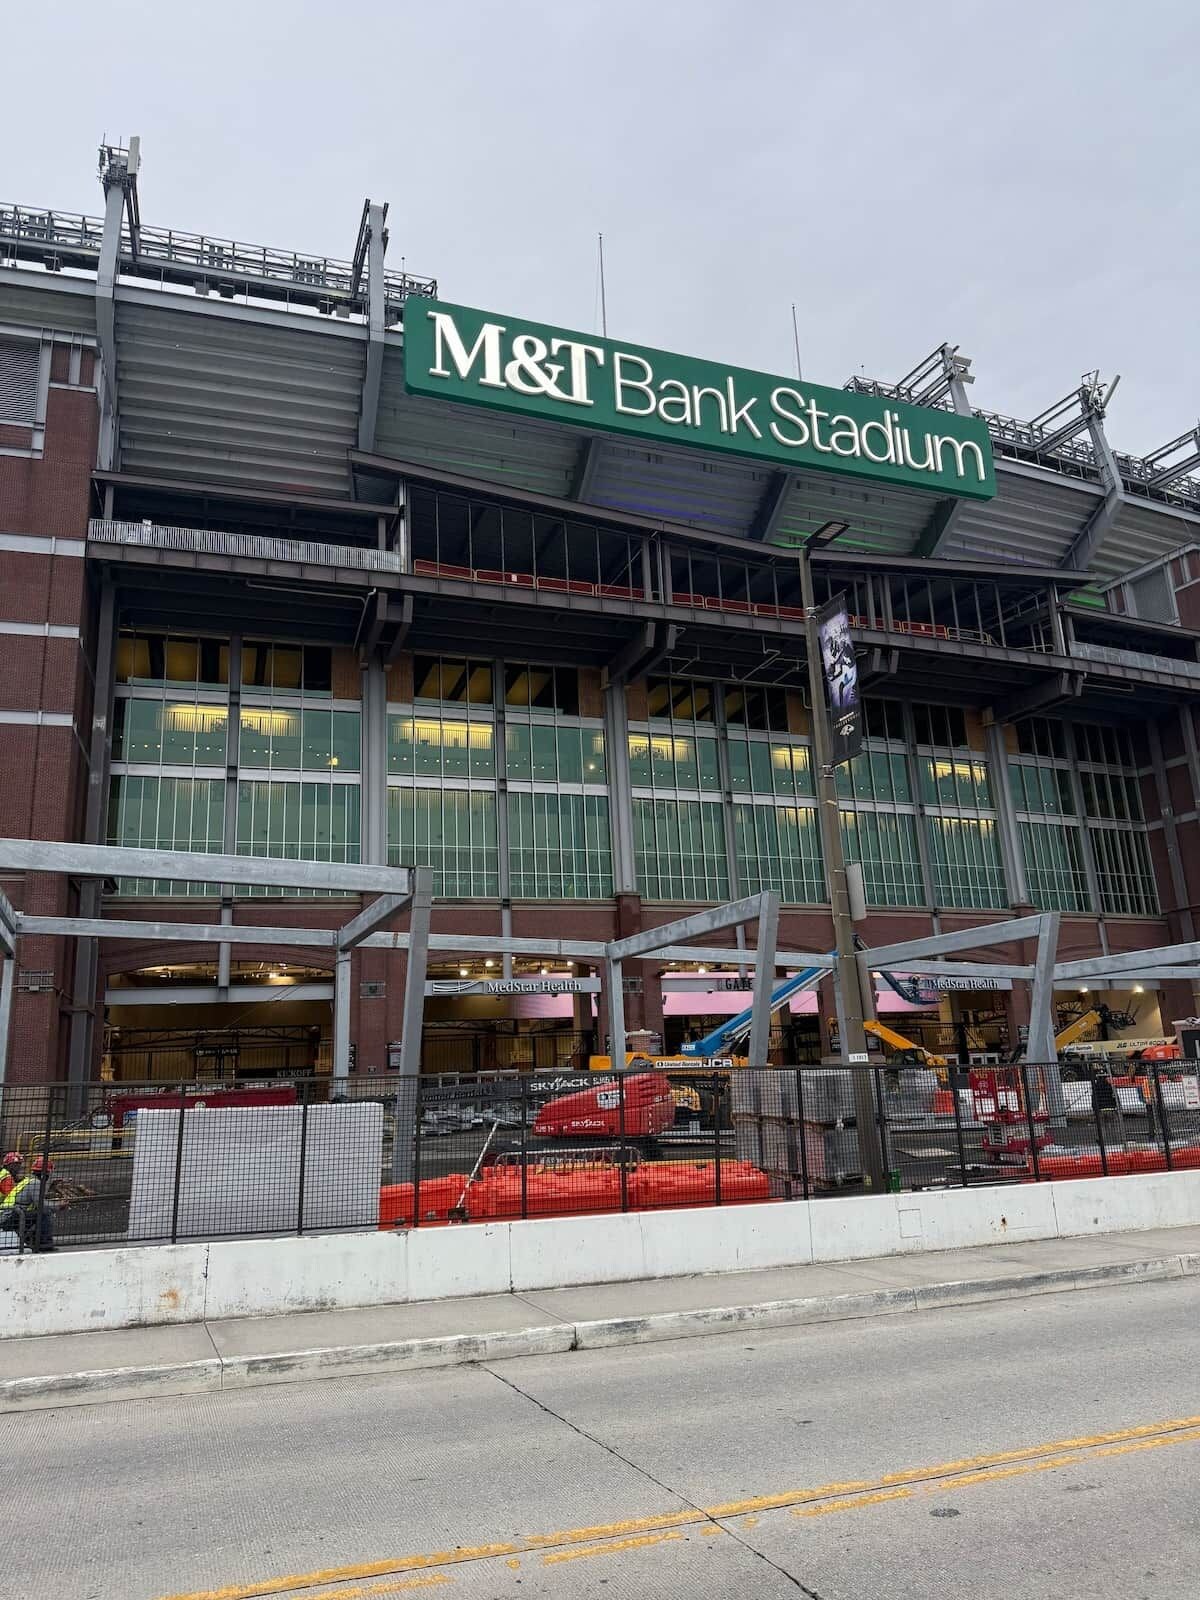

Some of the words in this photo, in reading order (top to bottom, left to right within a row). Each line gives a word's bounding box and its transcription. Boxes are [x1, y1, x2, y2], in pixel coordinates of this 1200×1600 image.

[427, 310, 604, 407] M&T
[613, 351, 762, 440] Bank
[768, 386, 987, 482] Stadium
[487, 980, 539, 993] MedStar
[541, 979, 583, 992] Health
[932, 977, 968, 990] MedStar
[969, 977, 1000, 990] Health
[703, 1058, 733, 1068] JCB
[529, 1077, 591, 1092] SKYJACK
